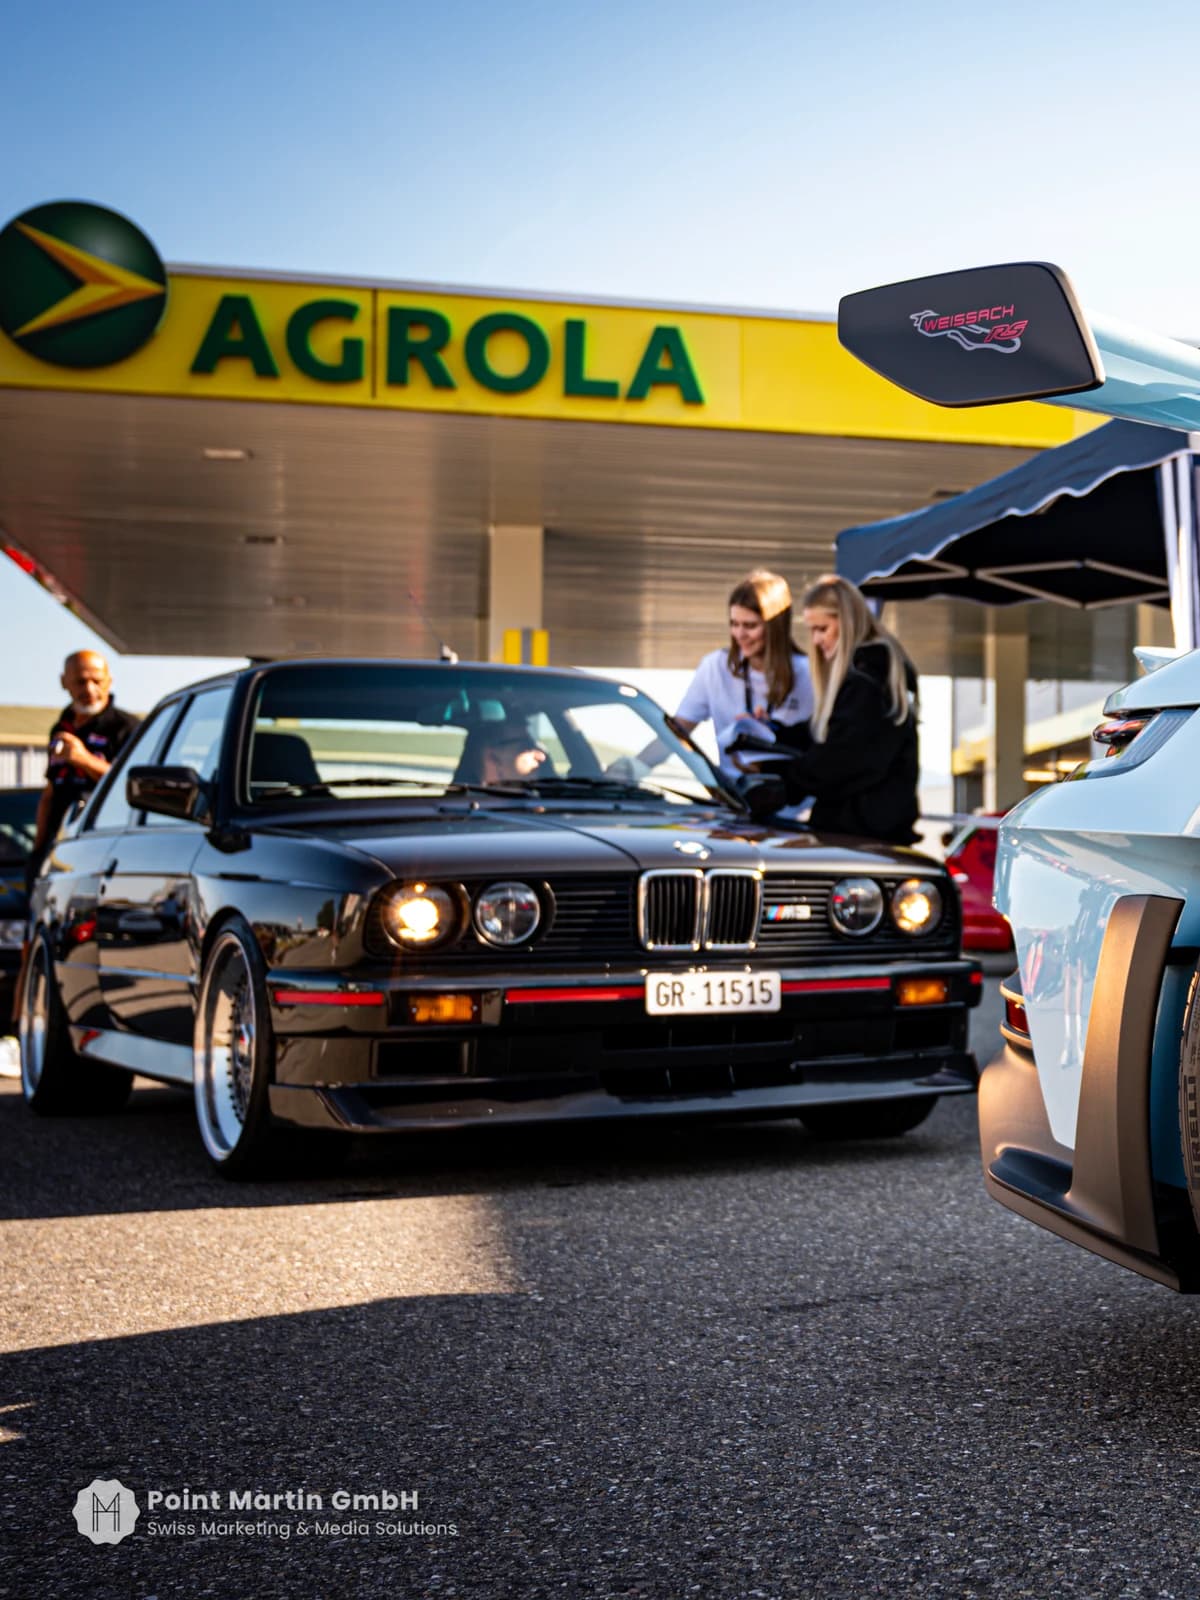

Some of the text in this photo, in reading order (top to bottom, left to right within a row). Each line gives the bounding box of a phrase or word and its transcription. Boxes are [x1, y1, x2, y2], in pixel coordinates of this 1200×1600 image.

[924, 304, 1015, 332] WEISSACH
[983, 319, 1029, 343] RS
[189, 295, 705, 406] AGROLA
[655, 980, 685, 1007] GR
[703, 979, 773, 1006] 11515
